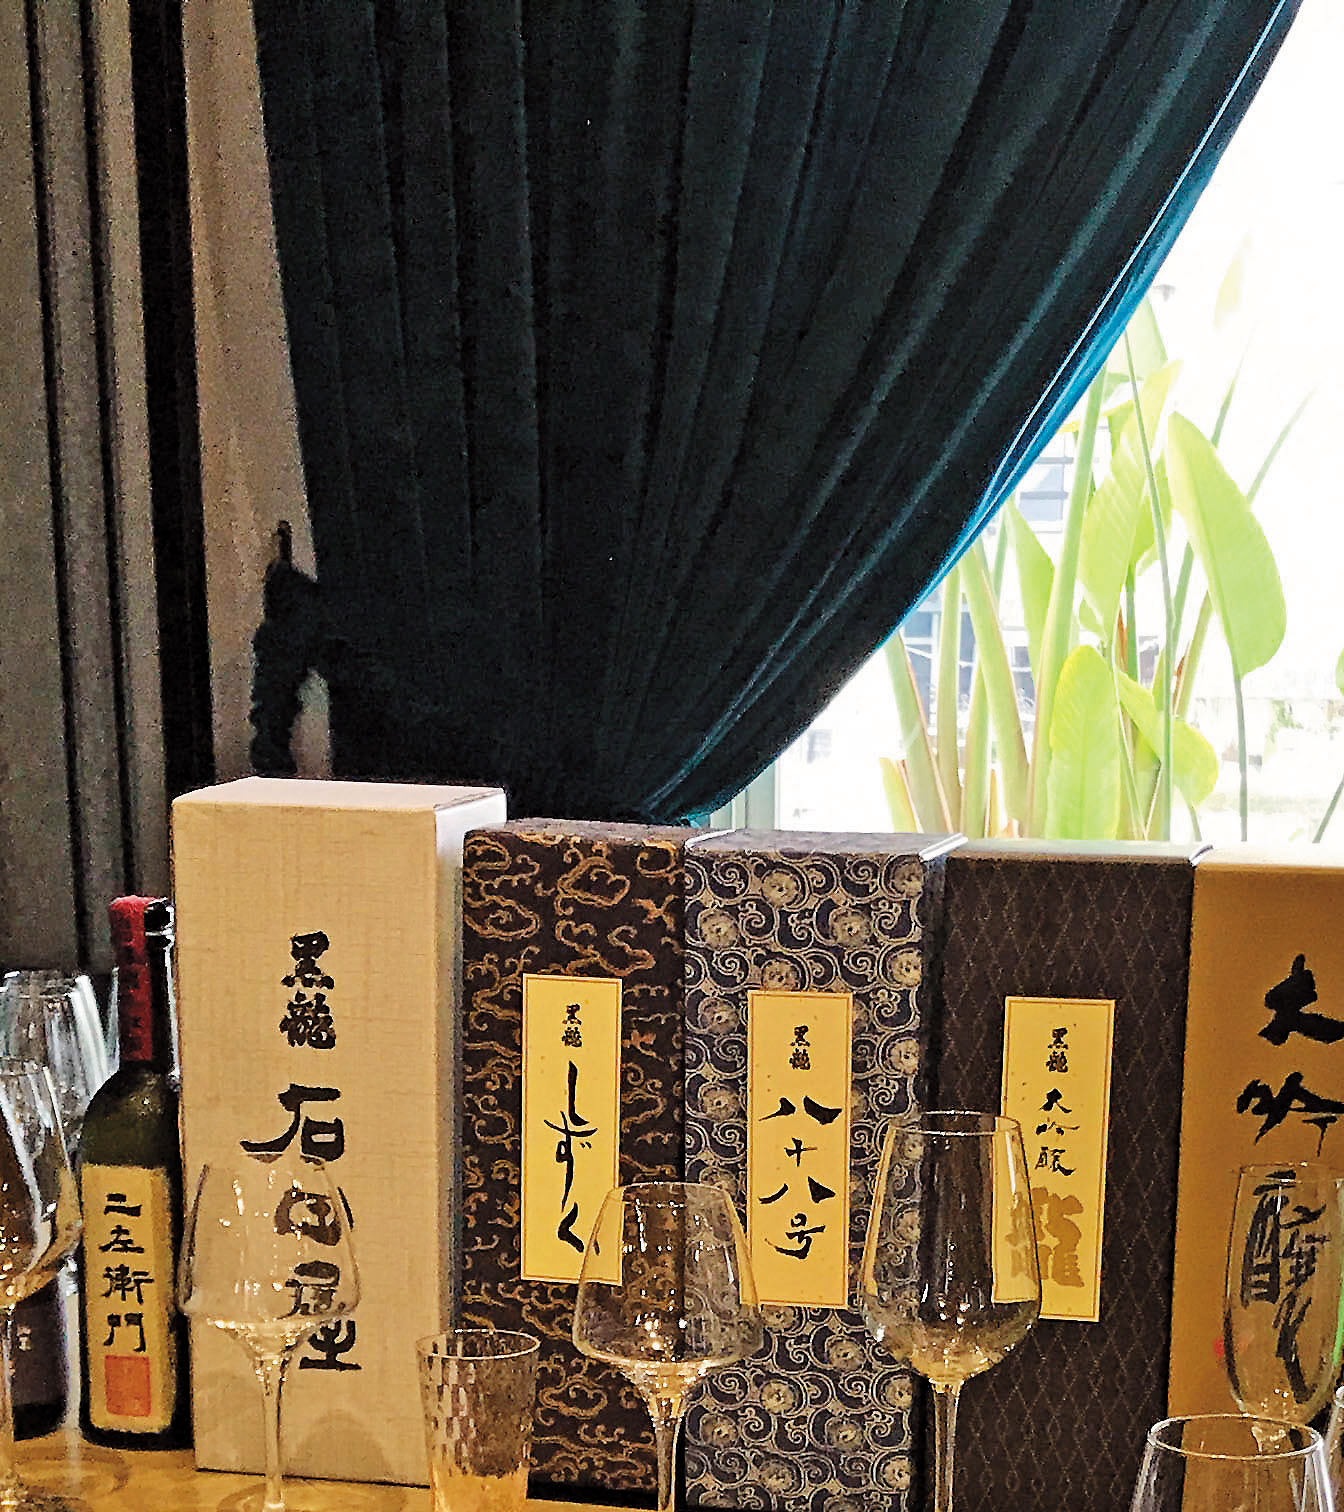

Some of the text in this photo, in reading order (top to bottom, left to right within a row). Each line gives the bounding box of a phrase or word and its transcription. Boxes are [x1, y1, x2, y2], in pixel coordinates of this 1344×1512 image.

[758, 1095, 846, 1260] 八十八号
[98, 1192, 155, 1353] 二左衛門
